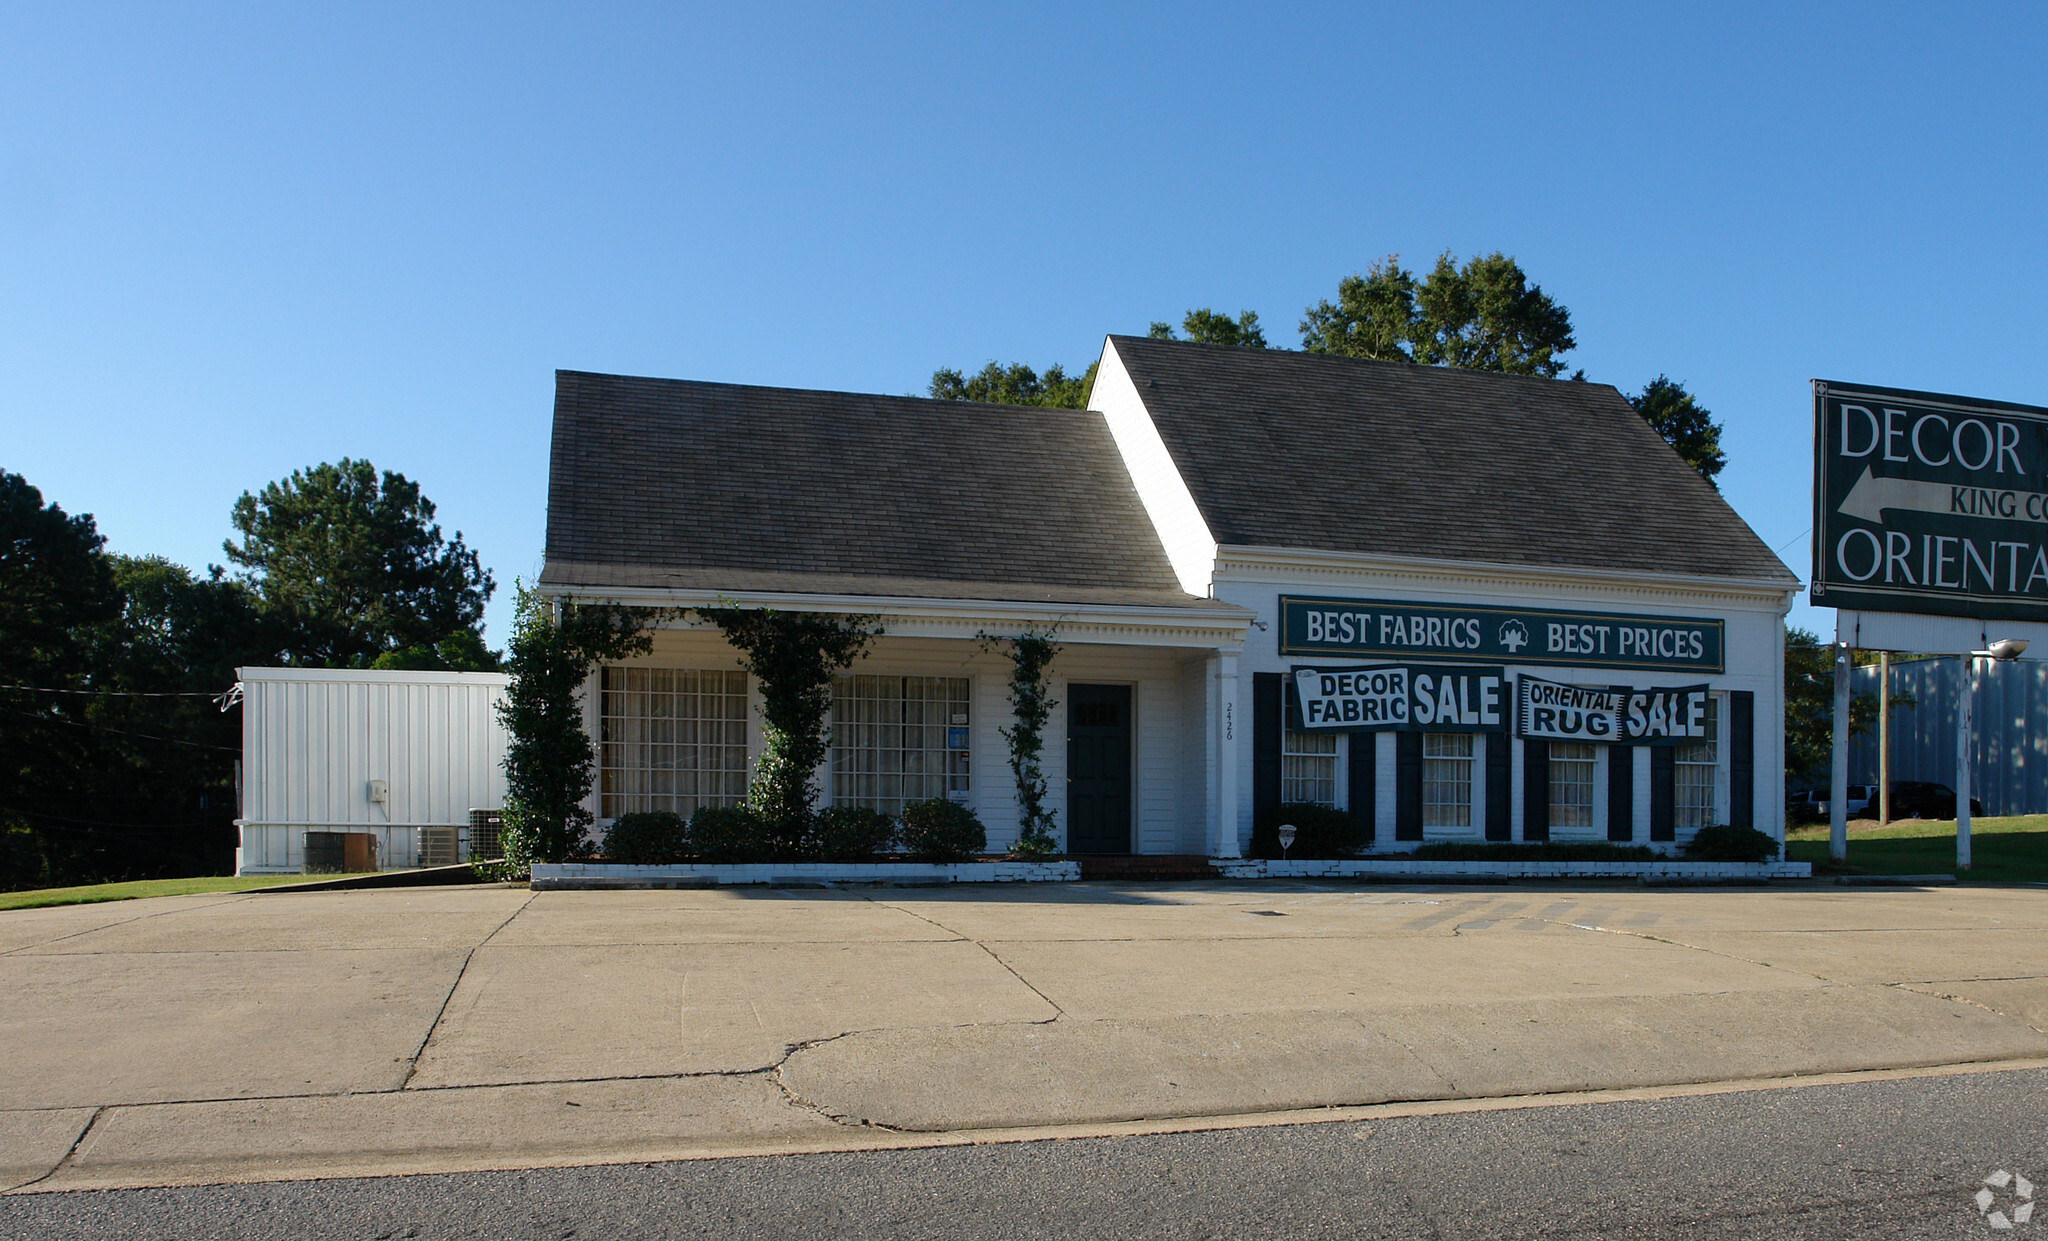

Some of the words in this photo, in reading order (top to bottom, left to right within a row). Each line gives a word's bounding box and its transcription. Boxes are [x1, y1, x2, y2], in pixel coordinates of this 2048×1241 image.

[1840, 404, 2025, 475] DECOR
[1950, 486, 2016, 518] KING
[1307, 611, 1371, 643] BEST
[1380, 614, 1481, 649] FABRICS
[1547, 623, 1610, 654] BEST
[1619, 627, 1703, 659] PRICES
[1321, 673, 1404, 696] DECOR
[1414, 673, 1500, 725] SALE
[1530, 684, 1614, 711] ORIENTAL
[1308, 697, 1406, 723] FABRIC
[1533, 707, 1610, 736] RUG
[1626, 691, 1705, 738] SALE
